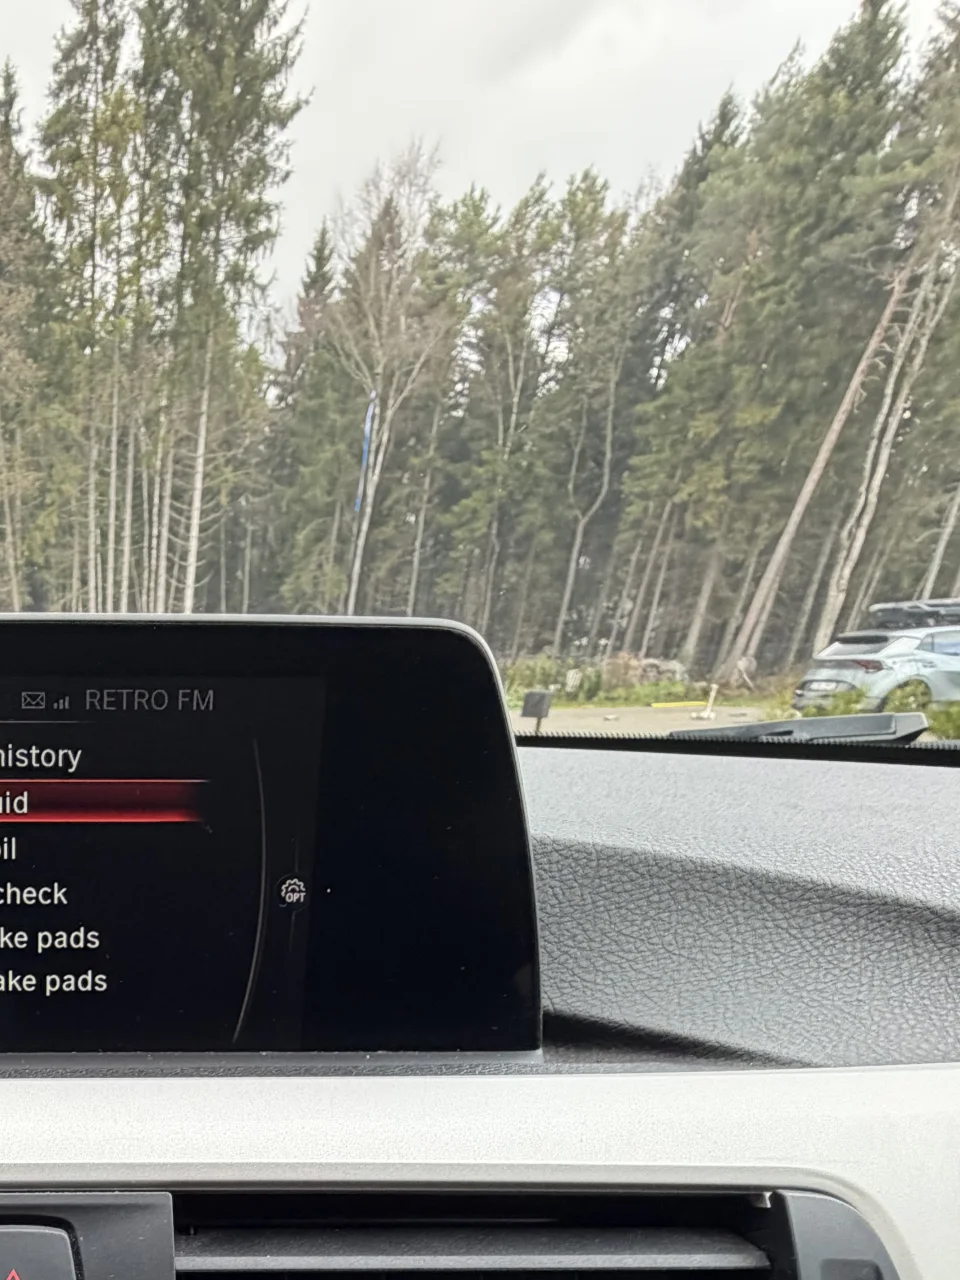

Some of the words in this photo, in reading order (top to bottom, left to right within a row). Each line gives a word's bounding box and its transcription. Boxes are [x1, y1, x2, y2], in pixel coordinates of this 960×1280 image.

[85, 689, 169, 711] RETRO
[178, 689, 214, 711] FM
[285, 892, 306, 903] OPT
[37, 926, 100, 954] pads
[45, 969, 108, 997] pads
